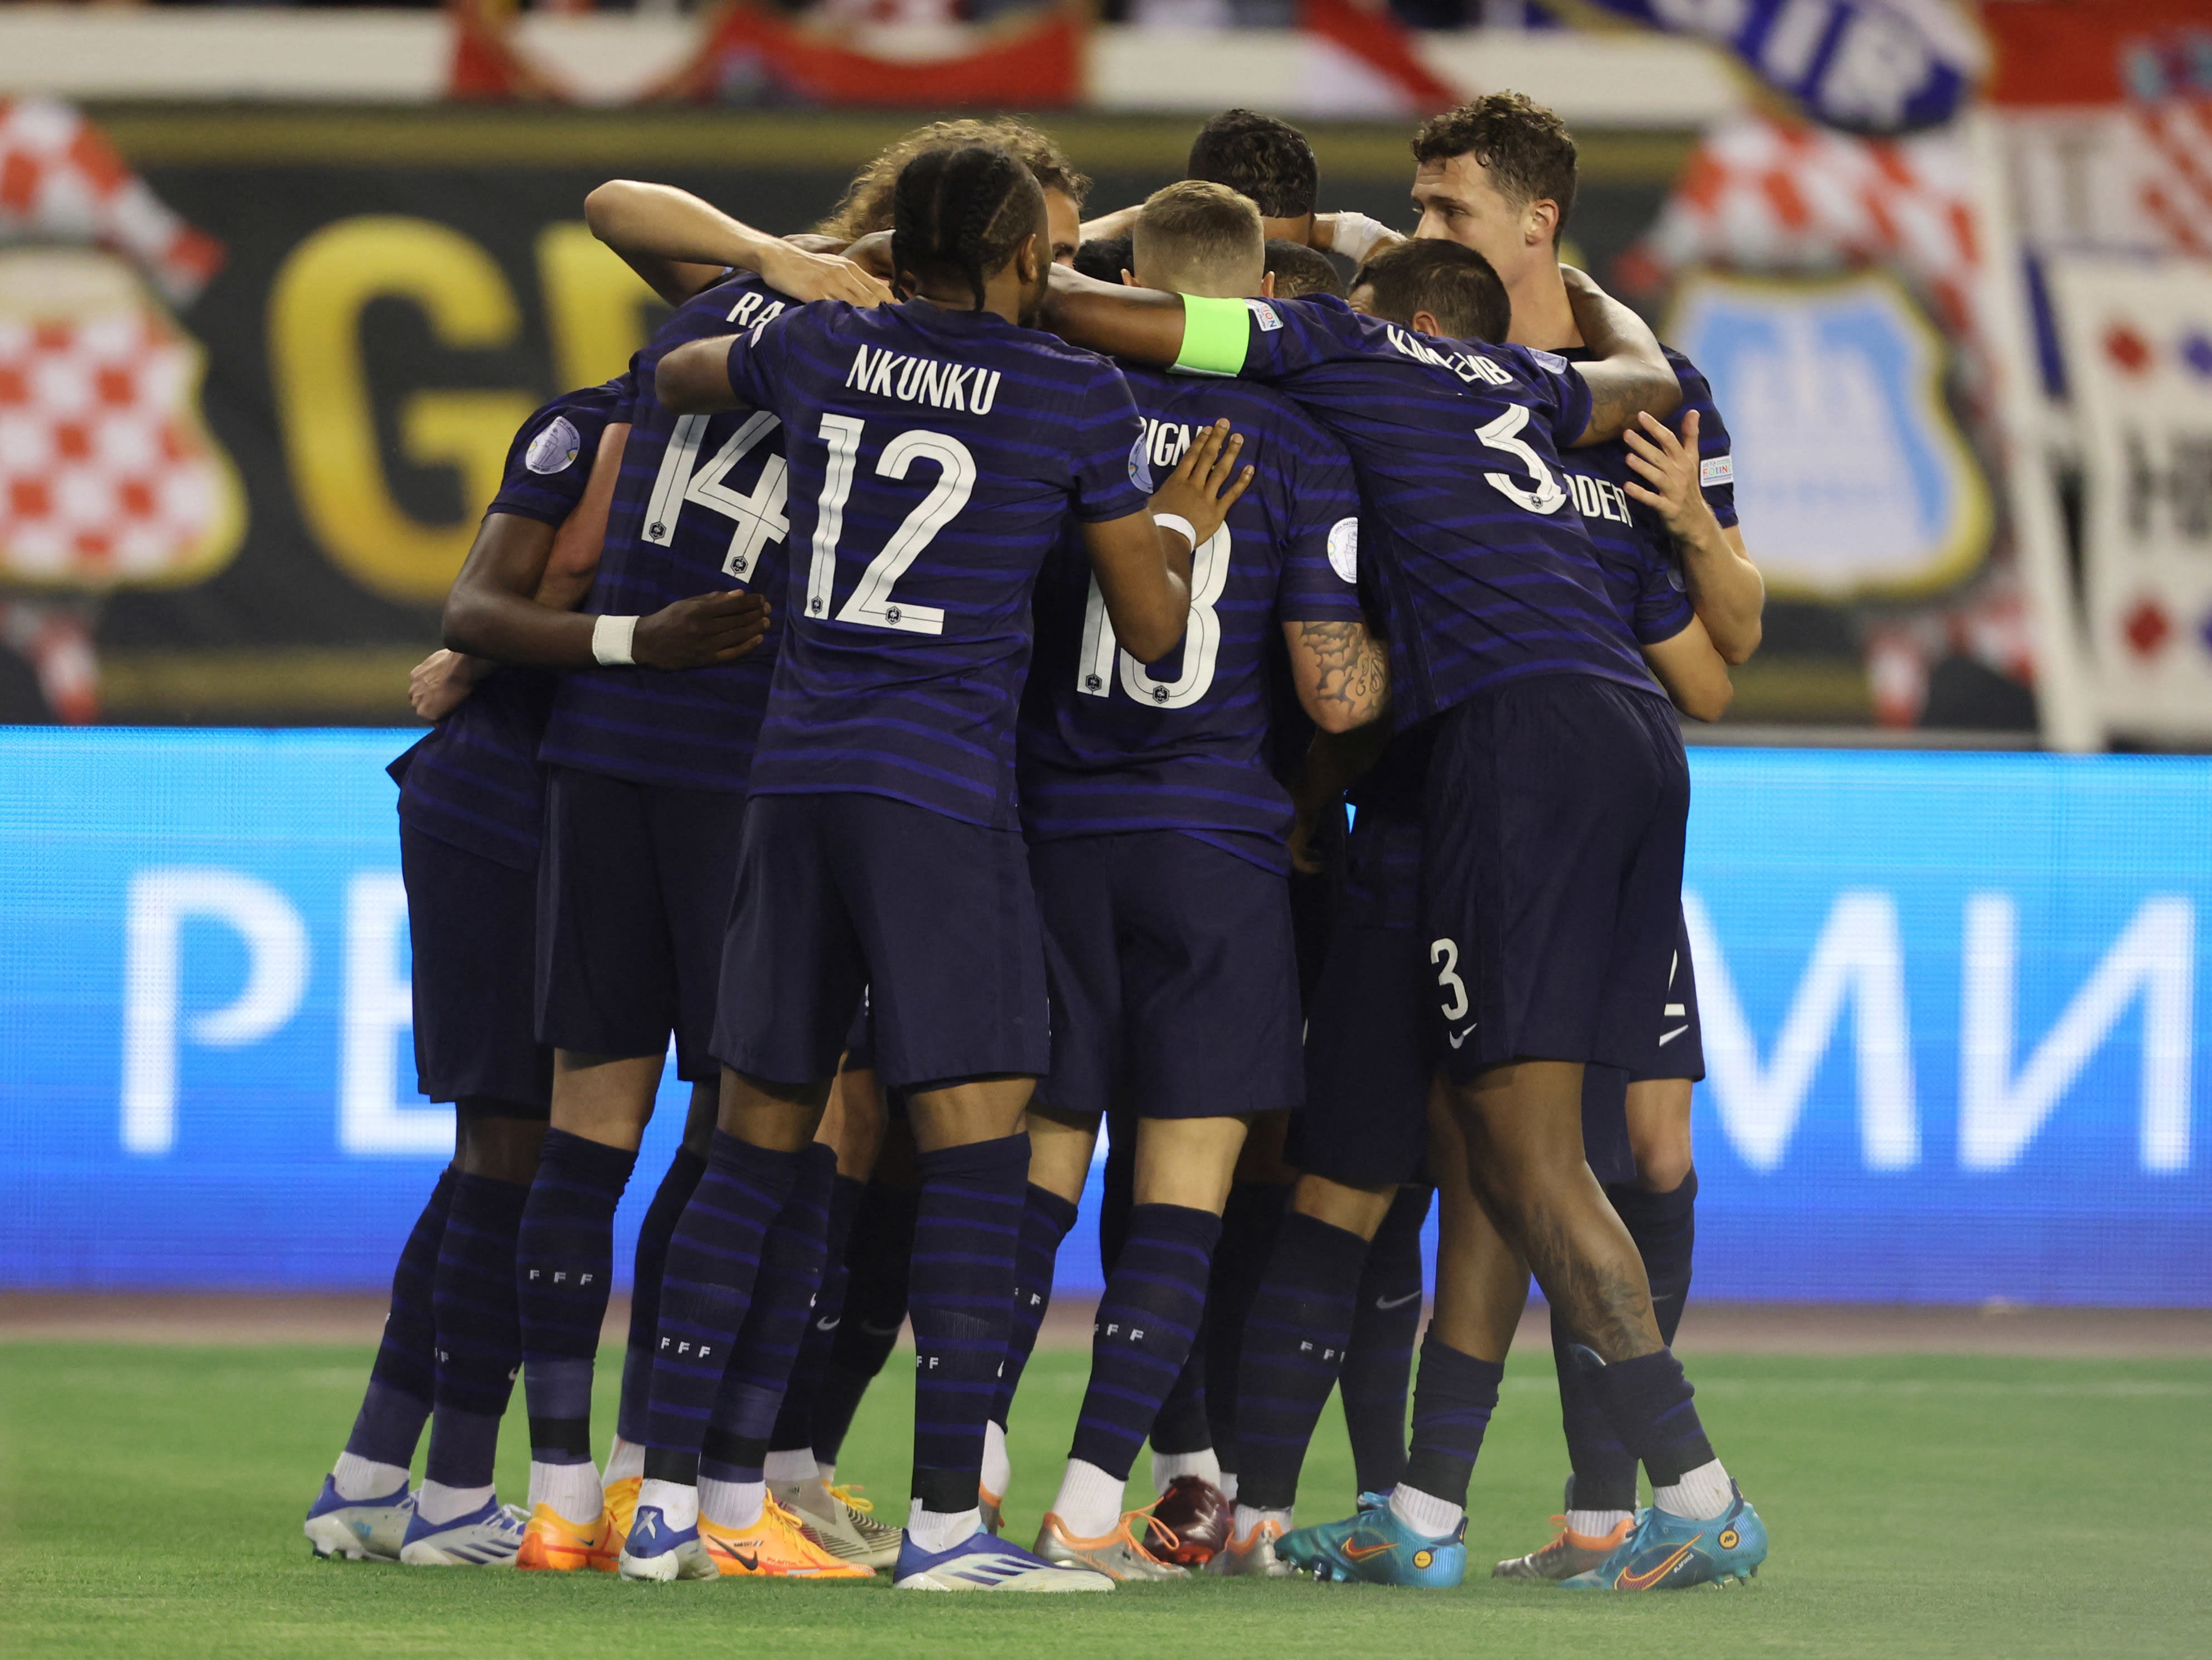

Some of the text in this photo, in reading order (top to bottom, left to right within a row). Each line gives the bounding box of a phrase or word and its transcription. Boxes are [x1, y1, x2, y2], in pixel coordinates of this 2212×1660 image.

[845, 343, 1001, 415] NKUNKU
[1139, 416, 1203, 467] IGN
[1474, 403, 1567, 515] 3
[641, 410, 790, 584] 14
[804, 413, 977, 635] 12
[1430, 937, 1469, 1021] 3
